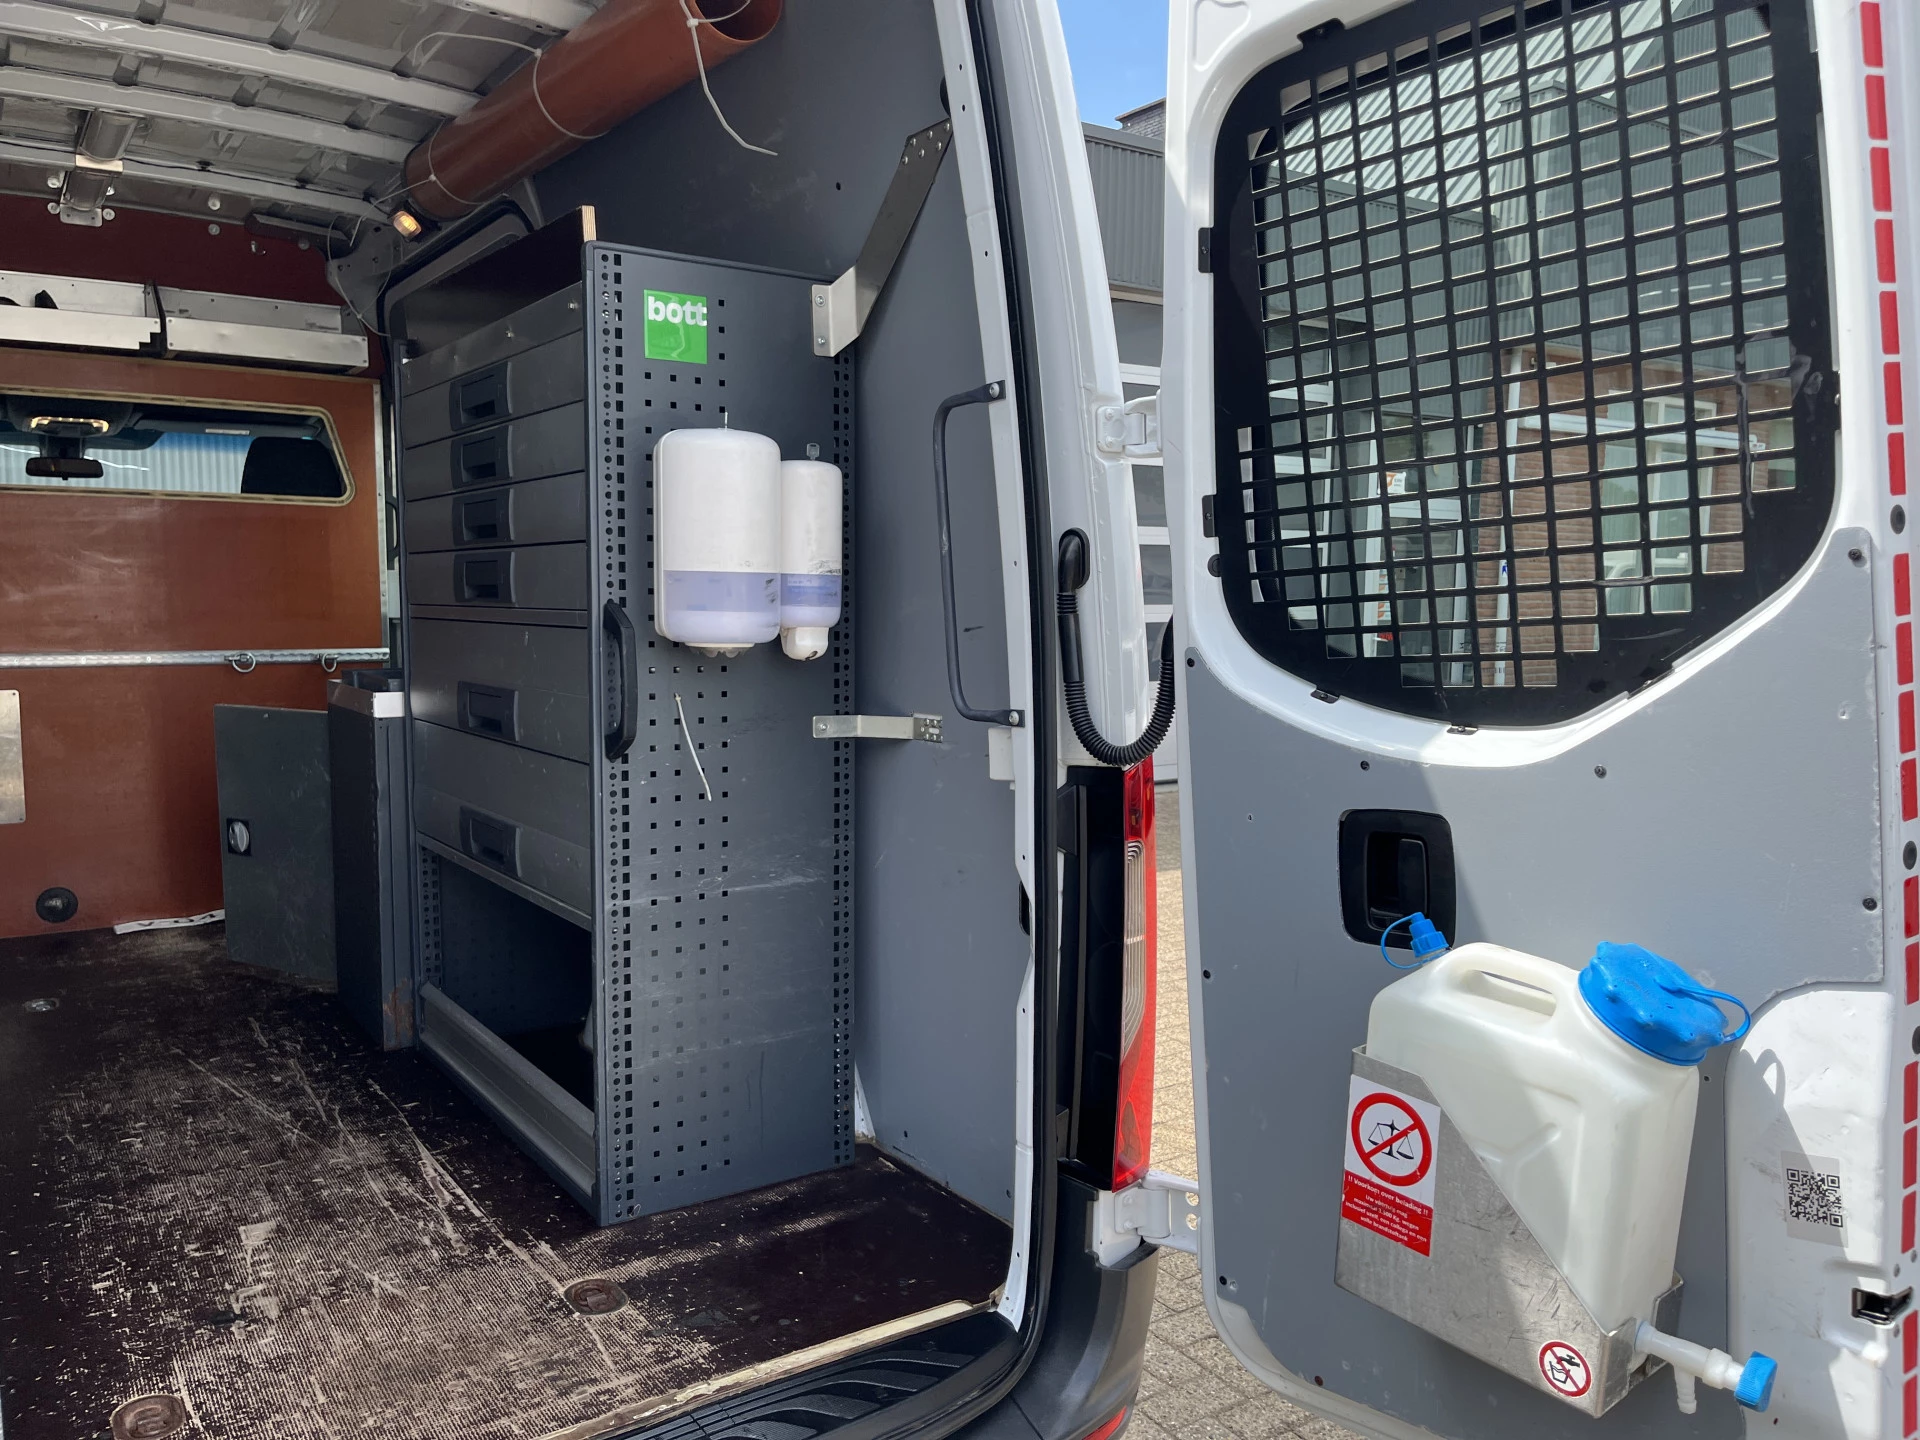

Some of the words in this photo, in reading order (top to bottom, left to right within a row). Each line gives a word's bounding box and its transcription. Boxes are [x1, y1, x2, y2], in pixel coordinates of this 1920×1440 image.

[648, 296, 707, 326] bott
[1353, 1177, 1380, 1194] Voorkom
[1380, 1190, 1394, 1201] over
[1395, 1196, 1422, 1214] belading
[1423, 1208, 1429, 1216] !!
[1396, 1209, 1408, 1218] mag
[1390, 1221, 1409, 1234] collega
[1416, 1234, 1427, 1242] een
[1401, 1219, 1420, 1231] wegen
